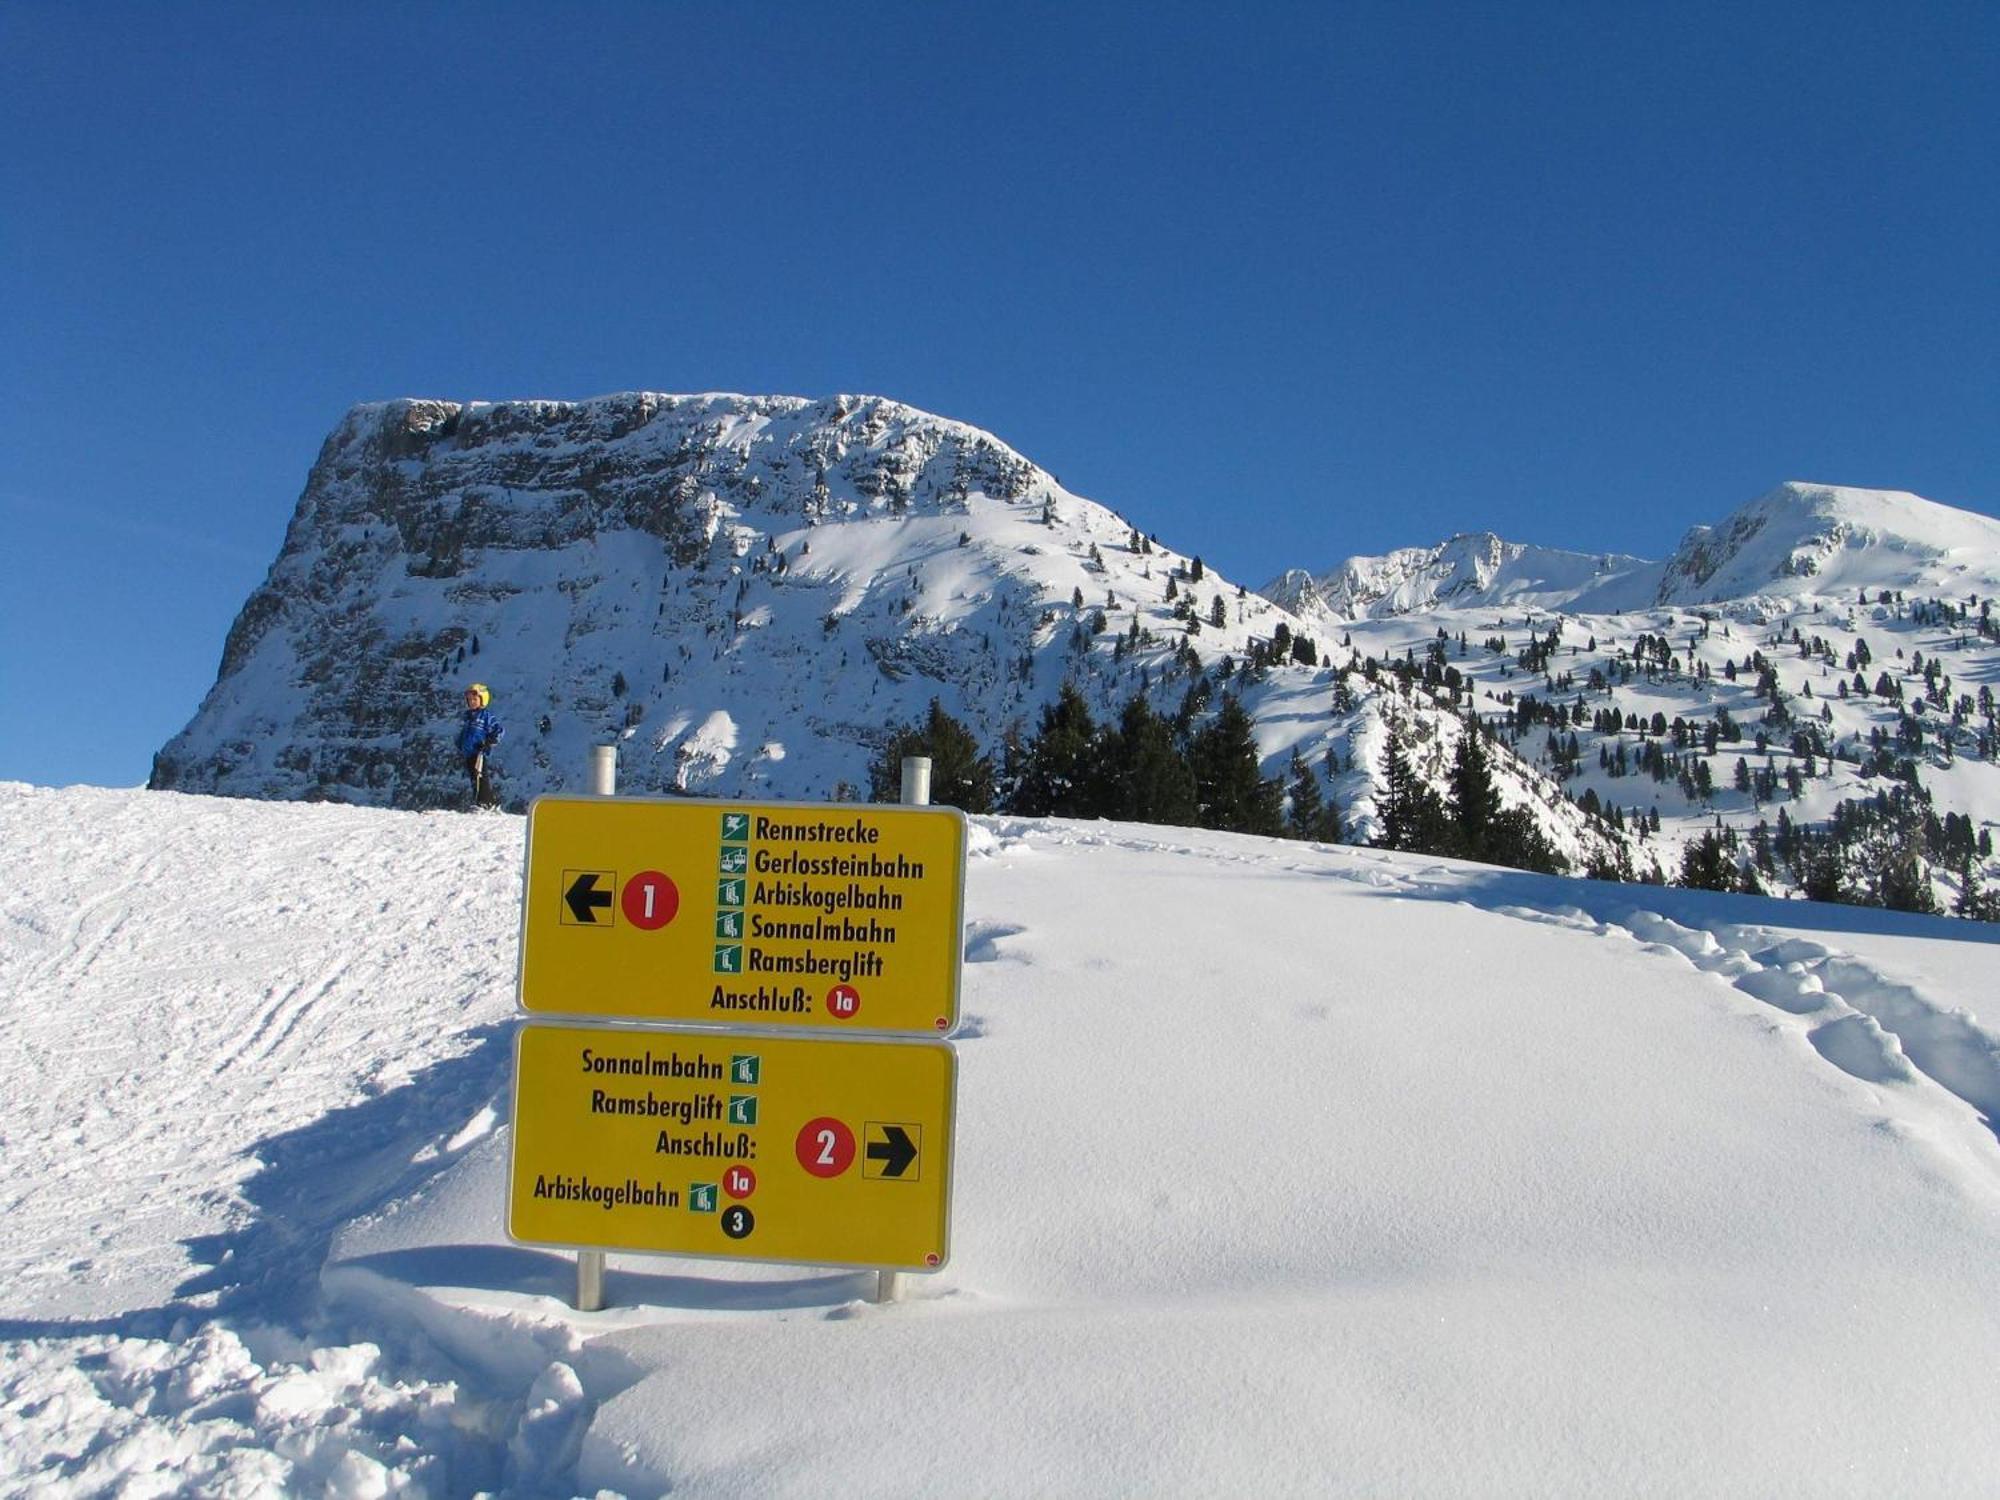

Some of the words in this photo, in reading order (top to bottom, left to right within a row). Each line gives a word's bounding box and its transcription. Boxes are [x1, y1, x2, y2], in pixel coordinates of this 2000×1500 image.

[756, 817, 878, 843] Rennstrecke
[755, 850, 923, 878] Gerlossteinbahn
[644, 885, 654, 917] 1
[753, 882, 901, 914] Arbiskogelbahn
[752, 915, 895, 943] Sonnalmbahn
[749, 948, 883, 982] Ramsberglift
[711, 986, 811, 1012] Anschluß:
[837, 991, 852, 1010] 1a
[583, 1049, 722, 1079] Sonnalmbahn
[592, 1090, 722, 1125] Ramsberglift
[656, 1131, 756, 1159] Anschluß:
[818, 1130, 835, 1164] 2
[534, 1175, 678, 1209] Arbiskogelbahn
[733, 1172, 748, 1190] 1a
[733, 1212, 743, 1231] 3
